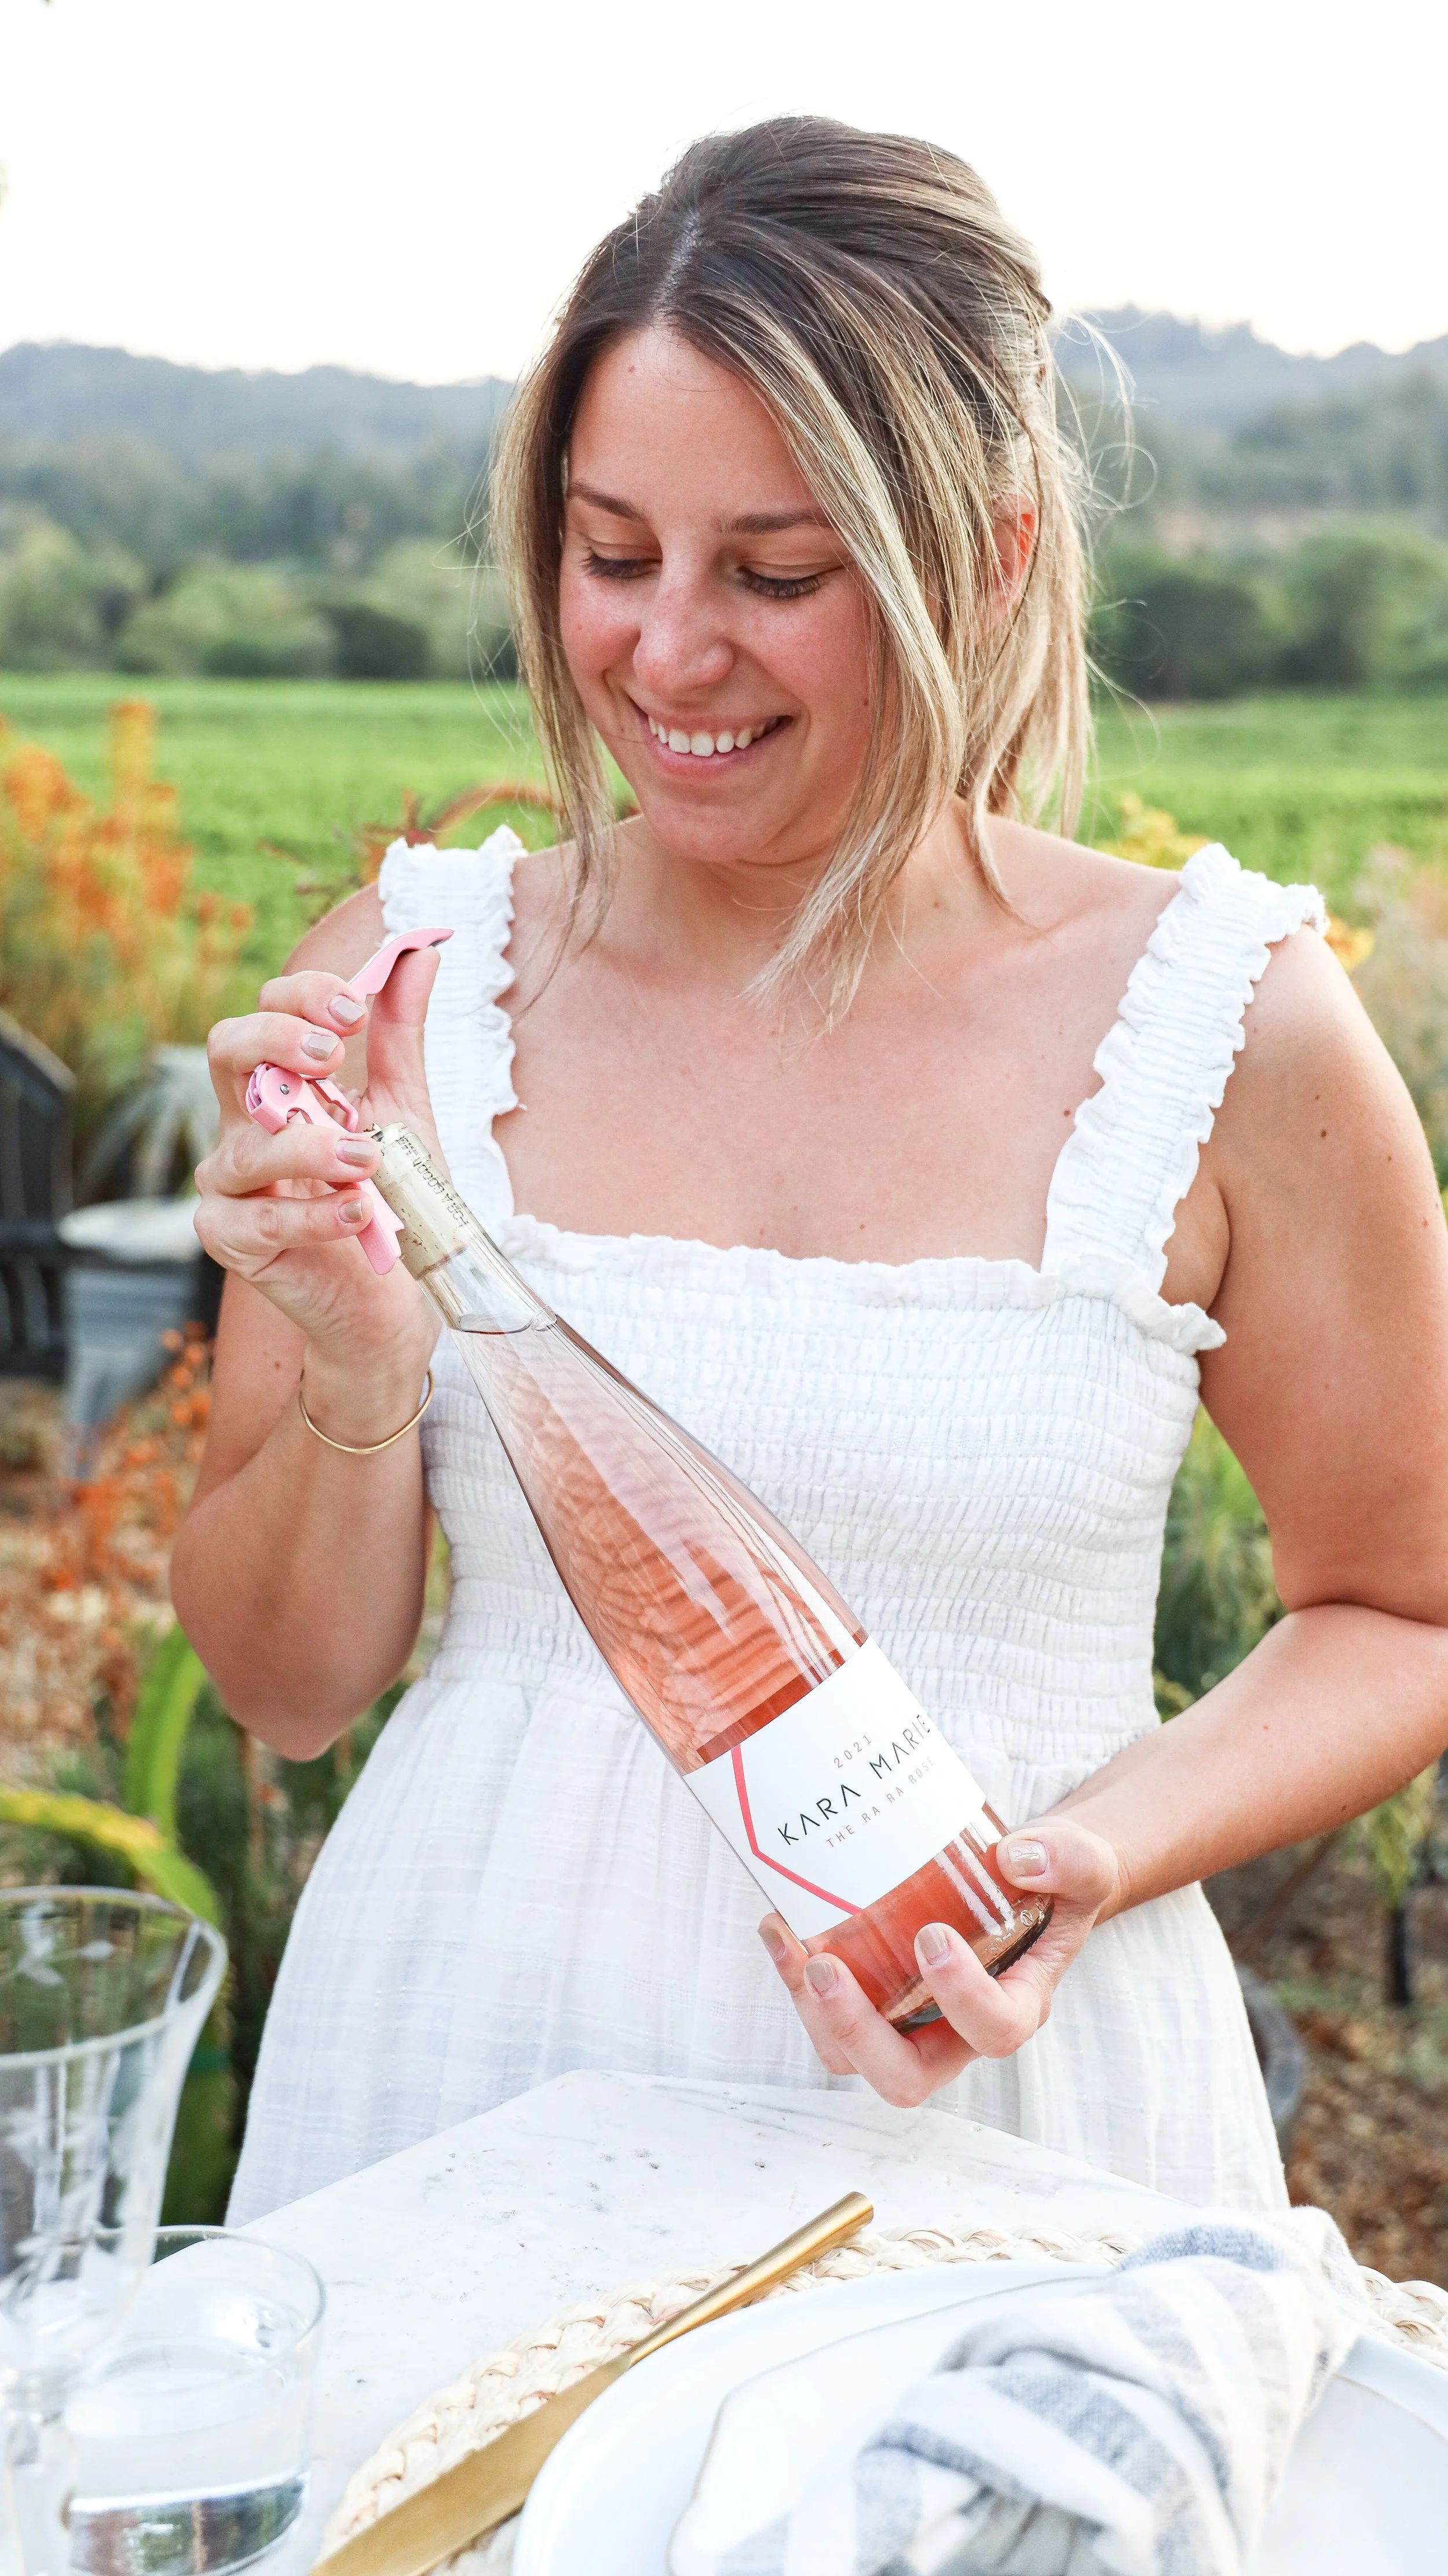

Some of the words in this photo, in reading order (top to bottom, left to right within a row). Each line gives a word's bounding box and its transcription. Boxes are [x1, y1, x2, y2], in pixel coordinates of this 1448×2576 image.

[777, 1784, 861, 1846] KARA
[869, 1714, 931, 1780] MARIE
[833, 1735, 872, 1768] 2021
[826, 1824, 855, 1848] THE
[861, 1806, 881, 1823] RA
[886, 1786, 904, 1804] RA
